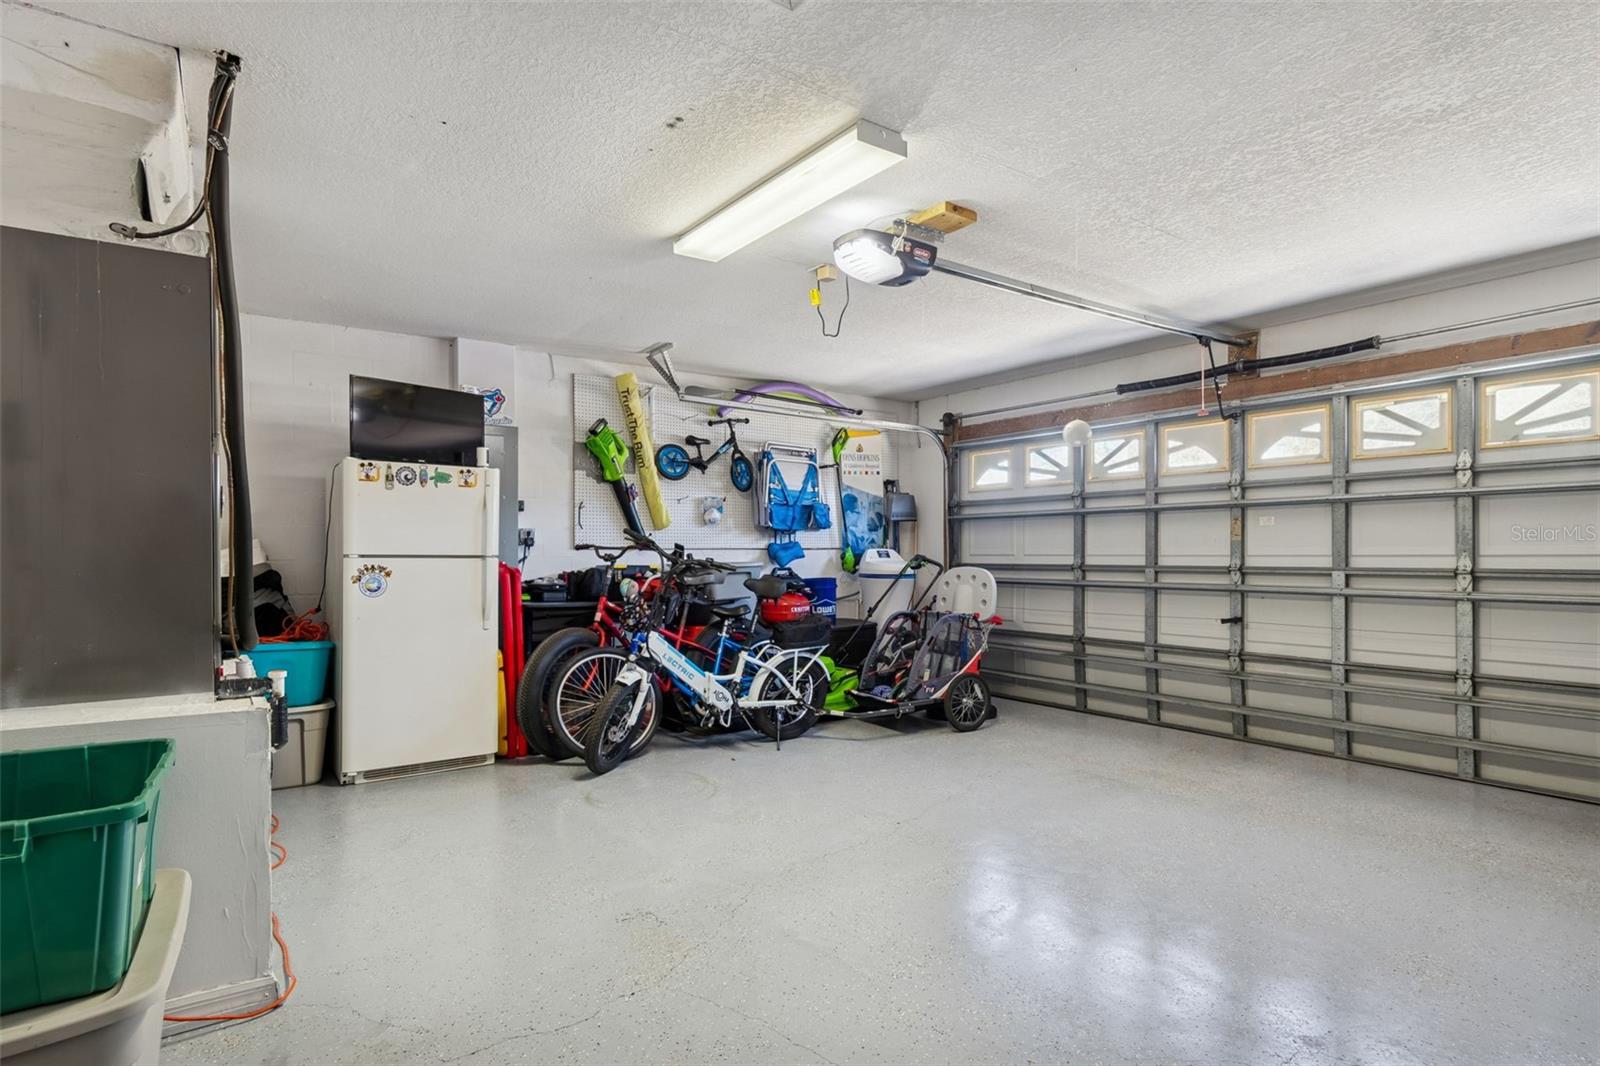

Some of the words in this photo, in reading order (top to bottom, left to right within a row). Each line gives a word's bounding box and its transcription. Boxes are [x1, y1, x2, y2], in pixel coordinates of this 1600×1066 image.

[621, 387, 634, 417] Trust
[629, 417, 638, 440] The
[662, 653, 695, 680] LECTRIC
